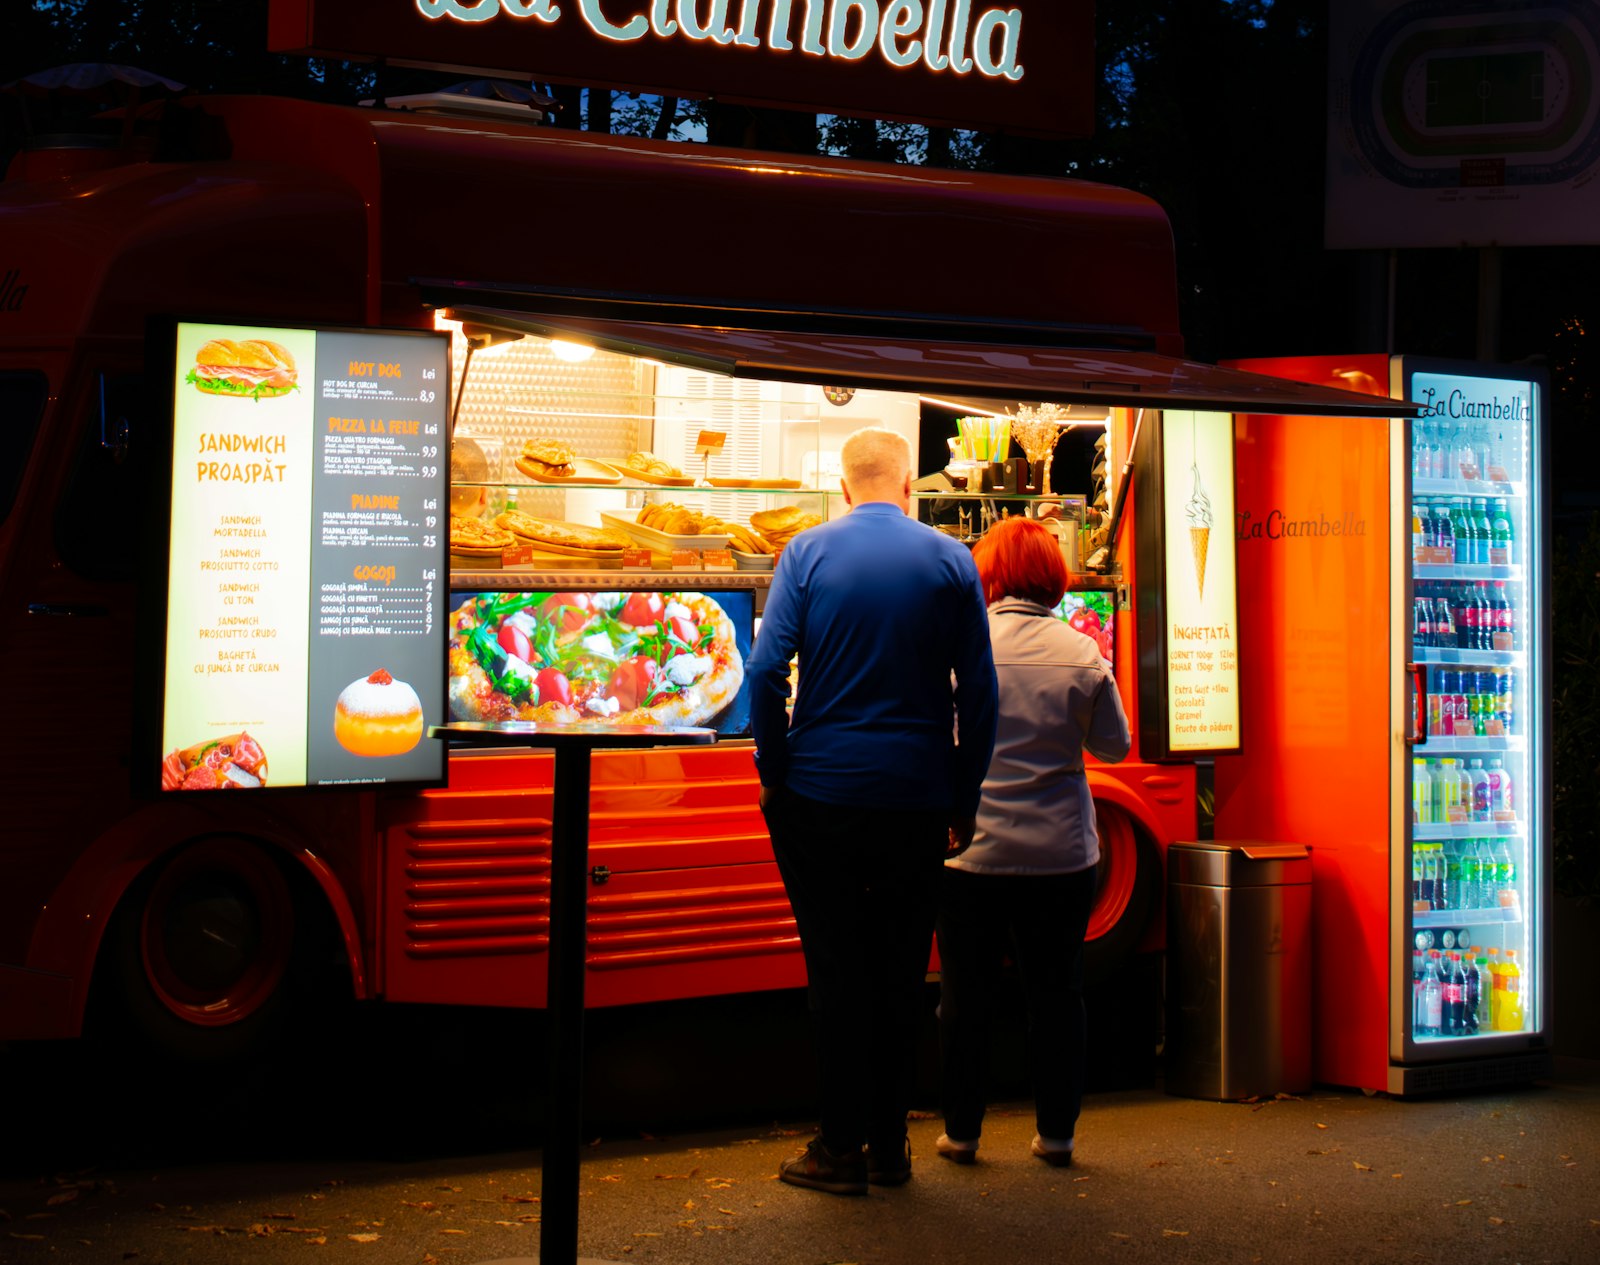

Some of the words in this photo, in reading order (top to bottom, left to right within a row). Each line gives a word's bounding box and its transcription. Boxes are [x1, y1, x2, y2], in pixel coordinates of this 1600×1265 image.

[349, 361, 375, 377] HOT
[378, 363, 402, 378] DOG
[422, 368, 436, 379] Lei
[420, 390, 435, 403] 8,9
[1418, 388, 1445, 418] La
[1449, 389, 1530, 421] Ciambella
[328, 417, 366, 433] PIZZA
[370, 419, 385, 433] LA
[389, 420, 420, 435] FELIE
[425, 424, 437, 434] Lei
[199, 433, 286, 454] SANDWICH
[325, 435, 342, 443] PIZZA
[422, 446, 437, 458] 9,9
[324, 456, 341, 464] PIZZA
[197, 457, 287, 484] PROASPĂT
[422, 466, 437, 478] 9,9
[351, 494, 400, 510] PIADINE
[424, 499, 437, 509] Lei
[220, 515, 261, 525] SANDWICH
[426, 516, 436, 528] 19
[1236, 511, 1262, 540] La
[1266, 510, 1367, 540] Ciambella
[214, 528, 267, 537] MORTADELLA
[423, 536, 436, 547] 25
[220, 549, 261, 559] SANDWICH
[201, 561, 249, 571] PROSCIUTTO
[252, 561, 279, 571] COTTO
[354, 565, 396, 586] GOGOȘI
[422, 569, 436, 580] Lei
[219, 583, 260, 593] SANDWICH
[426, 582, 432, 591] 4
[223, 596, 233, 605] CU
[237, 596, 254, 605] TON
[426, 592, 432, 602] 7
[426, 603, 432, 613] 8
[218, 616, 259, 626] SANDWICH
[426, 613, 432, 623] 8
[199, 629, 248, 639] PROSCIUTTO
[251, 629, 277, 638] CRUDO
[426, 624, 432, 634] 7
[1174, 622, 1230, 644] ÎNGHEȚATĂ
[218, 649, 256, 661] BAGHETĂ
[194, 664, 204, 674] CU
[207, 662, 232, 677] ȘUNCĂ
[236, 664, 245, 673] DE
[248, 663, 280, 673] CURCAN
